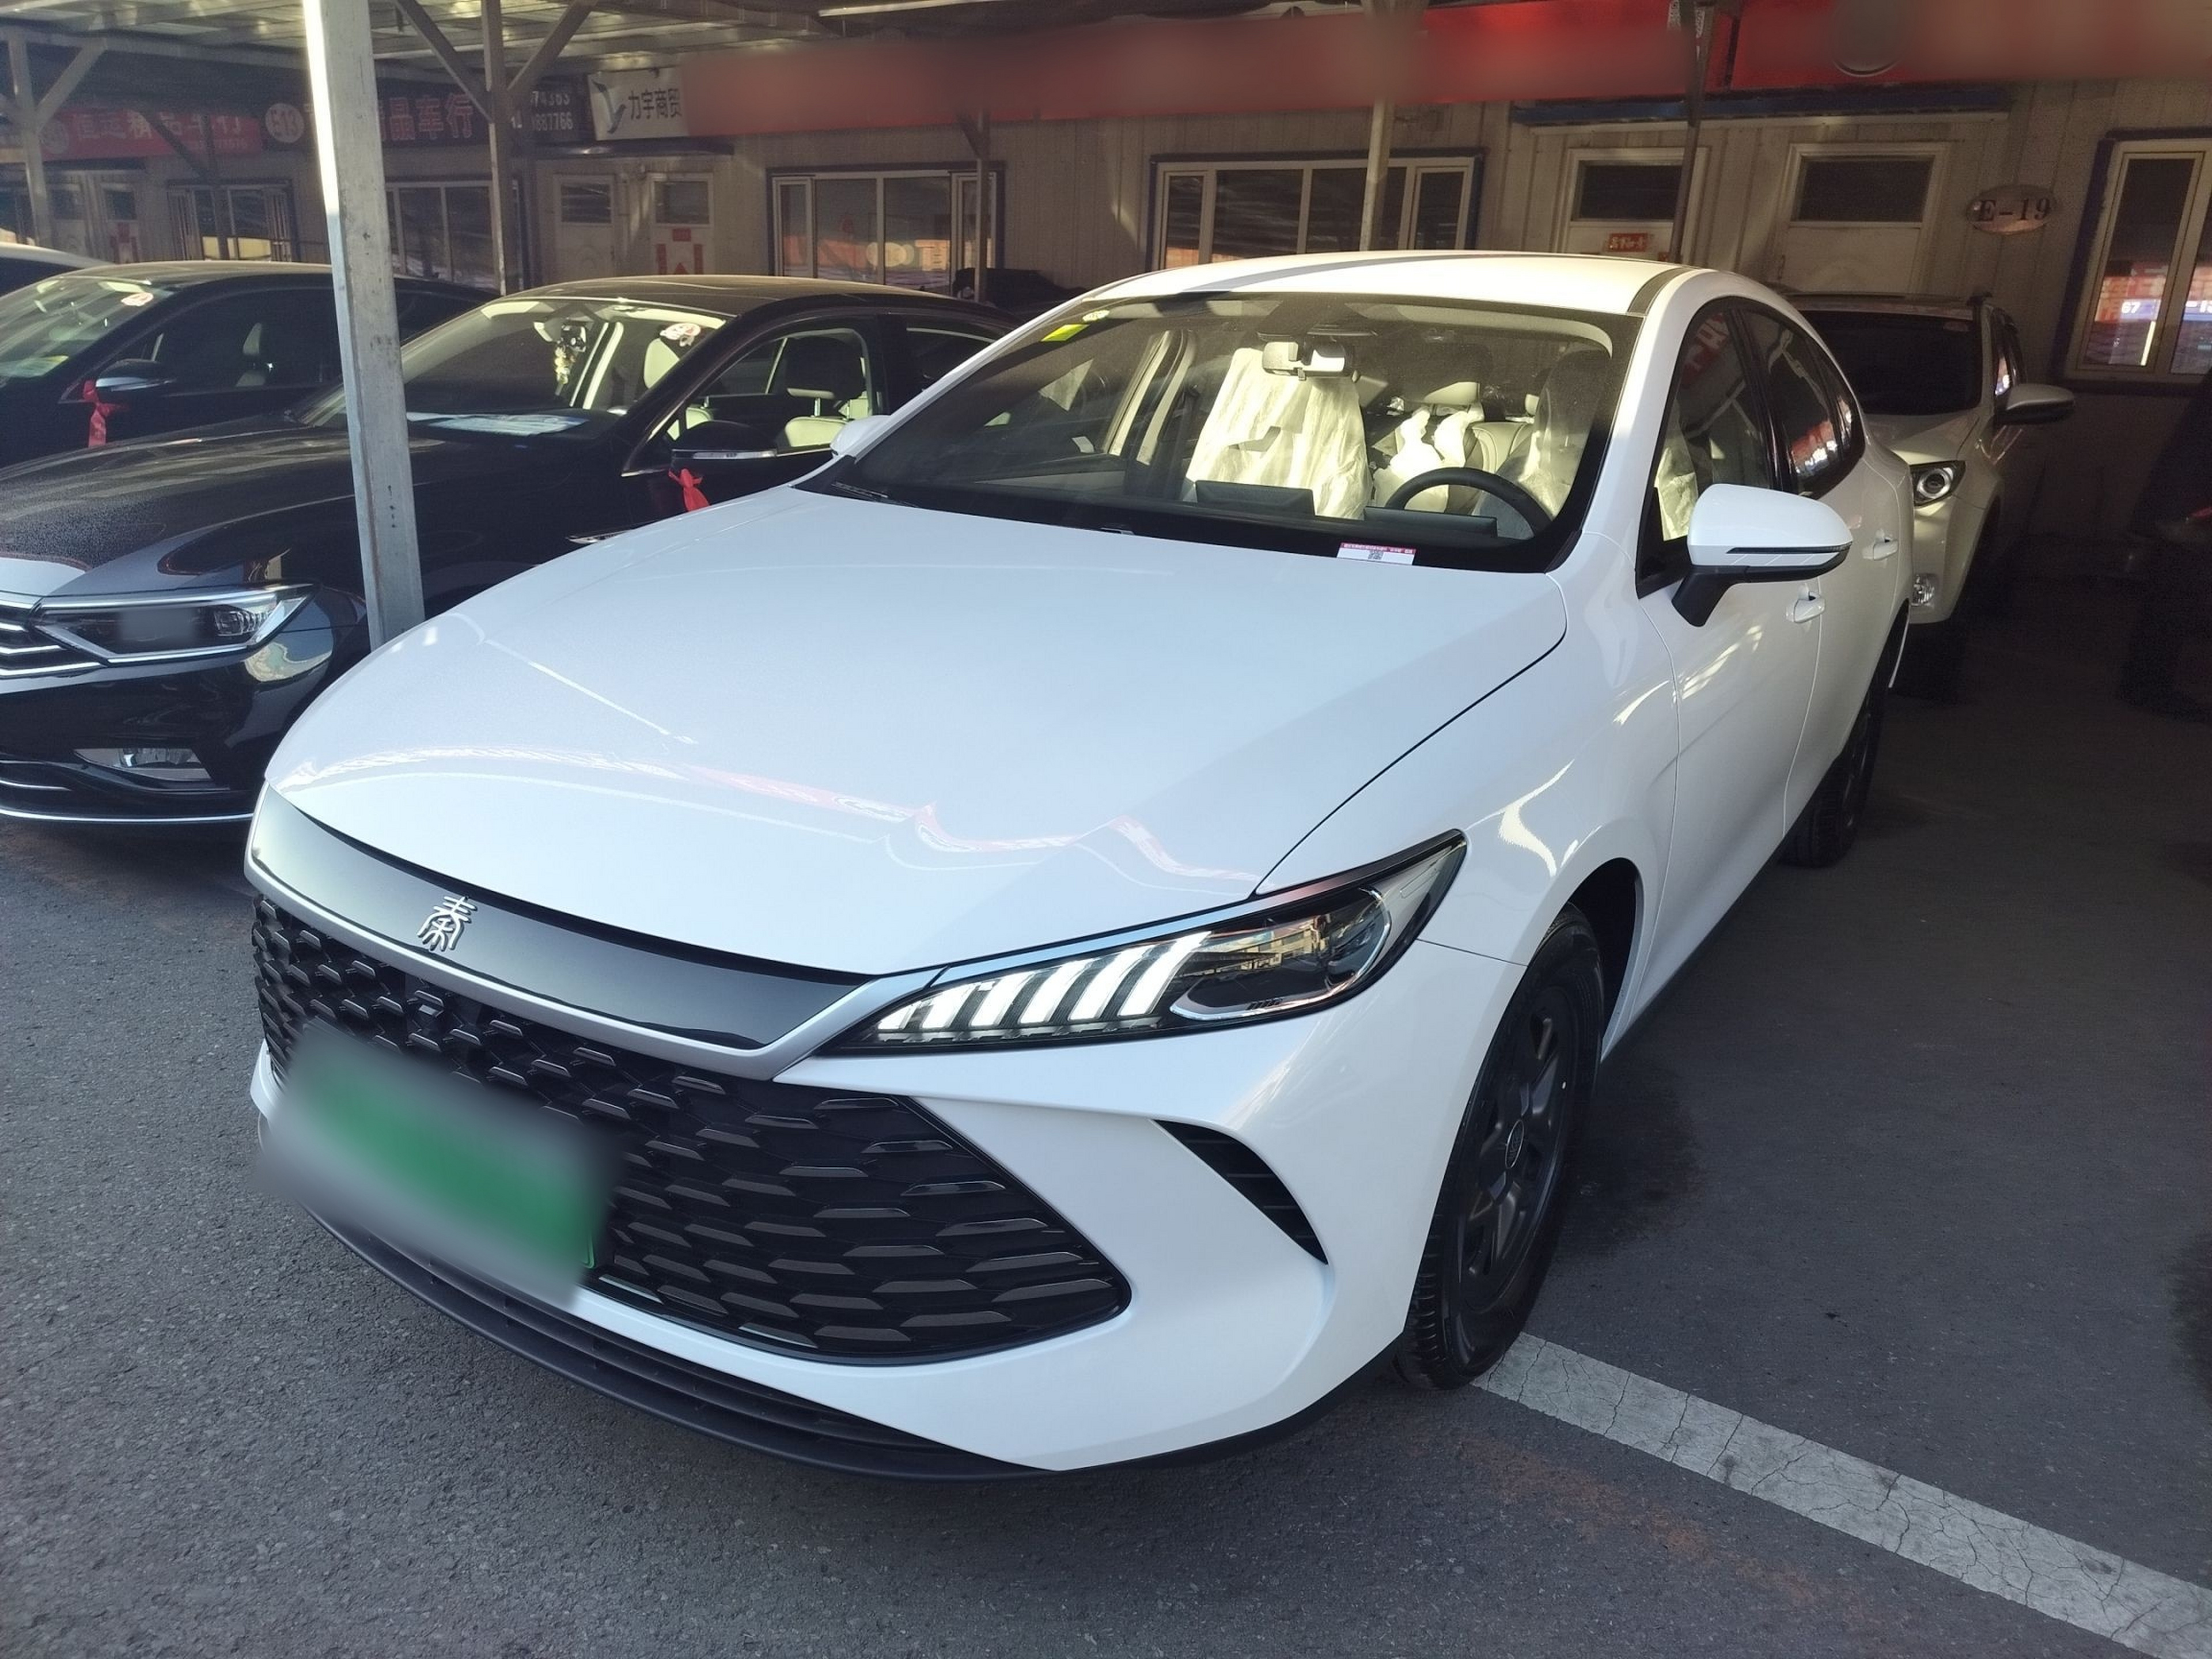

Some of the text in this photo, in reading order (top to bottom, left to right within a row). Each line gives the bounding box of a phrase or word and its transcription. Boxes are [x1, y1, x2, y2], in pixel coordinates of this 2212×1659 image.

[628, 88, 682, 120] 力宇商贸
[1978, 198, 2051, 221] E-19
